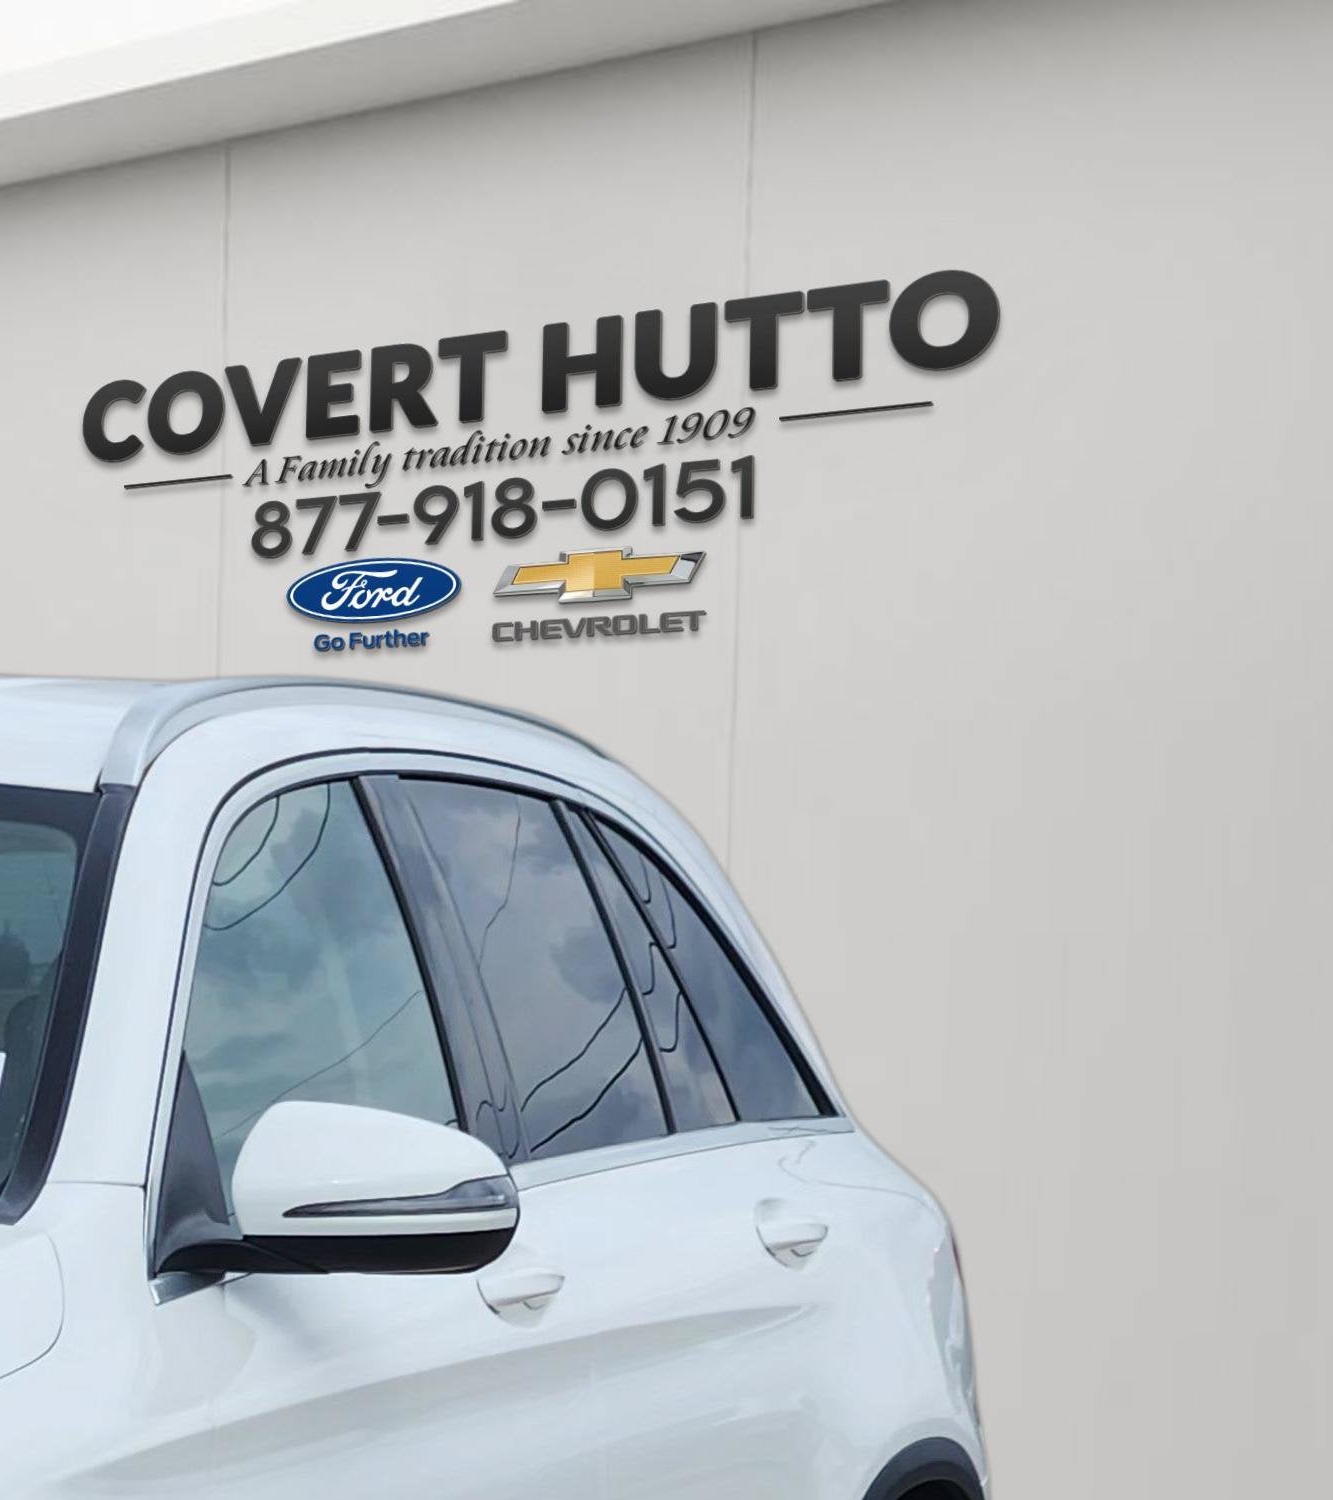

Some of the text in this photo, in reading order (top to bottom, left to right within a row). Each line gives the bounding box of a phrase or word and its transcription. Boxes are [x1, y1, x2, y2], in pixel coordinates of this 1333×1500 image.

[82, 269, 1001, 465] COVERT HUTTO
[242, 406, 757, 491] A Family tradition since 1909
[250, 454, 756, 560] 877-918-0151
[321, 569, 422, 612] Ford
[313, 628, 431, 653] Go Further
[491, 610, 708, 645] CHEVROLET
